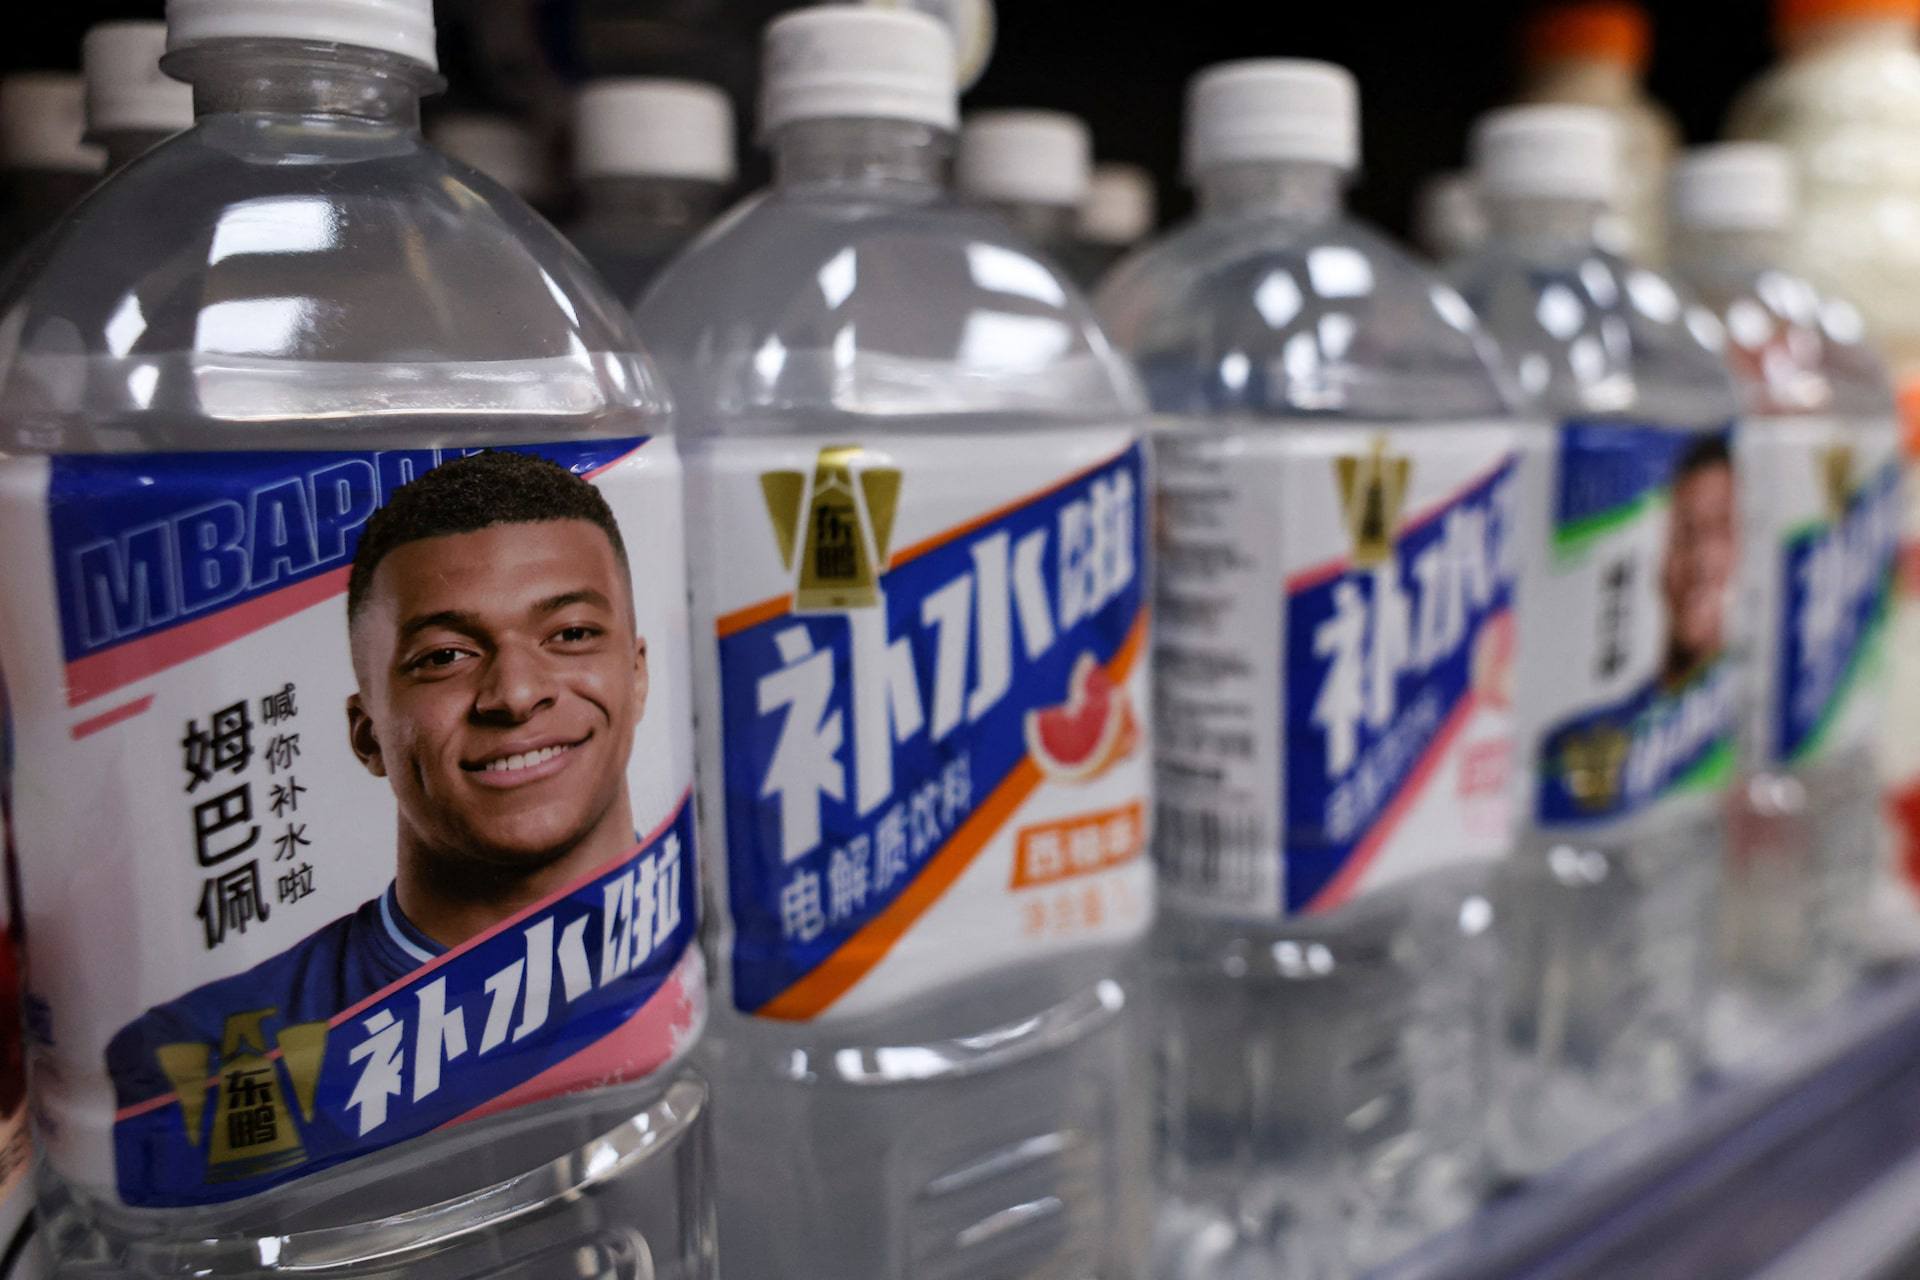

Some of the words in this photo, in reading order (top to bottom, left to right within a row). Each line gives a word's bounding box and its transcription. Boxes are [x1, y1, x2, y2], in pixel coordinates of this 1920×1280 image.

[261, 682, 316, 904] 喊你补水啦
[756, 467, 1136, 866] 补水啦
[183, 698, 270, 951] 姆巴佩
[225, 1067, 278, 1149] 东鹏
[345, 830, 681, 1137] 补水啦
